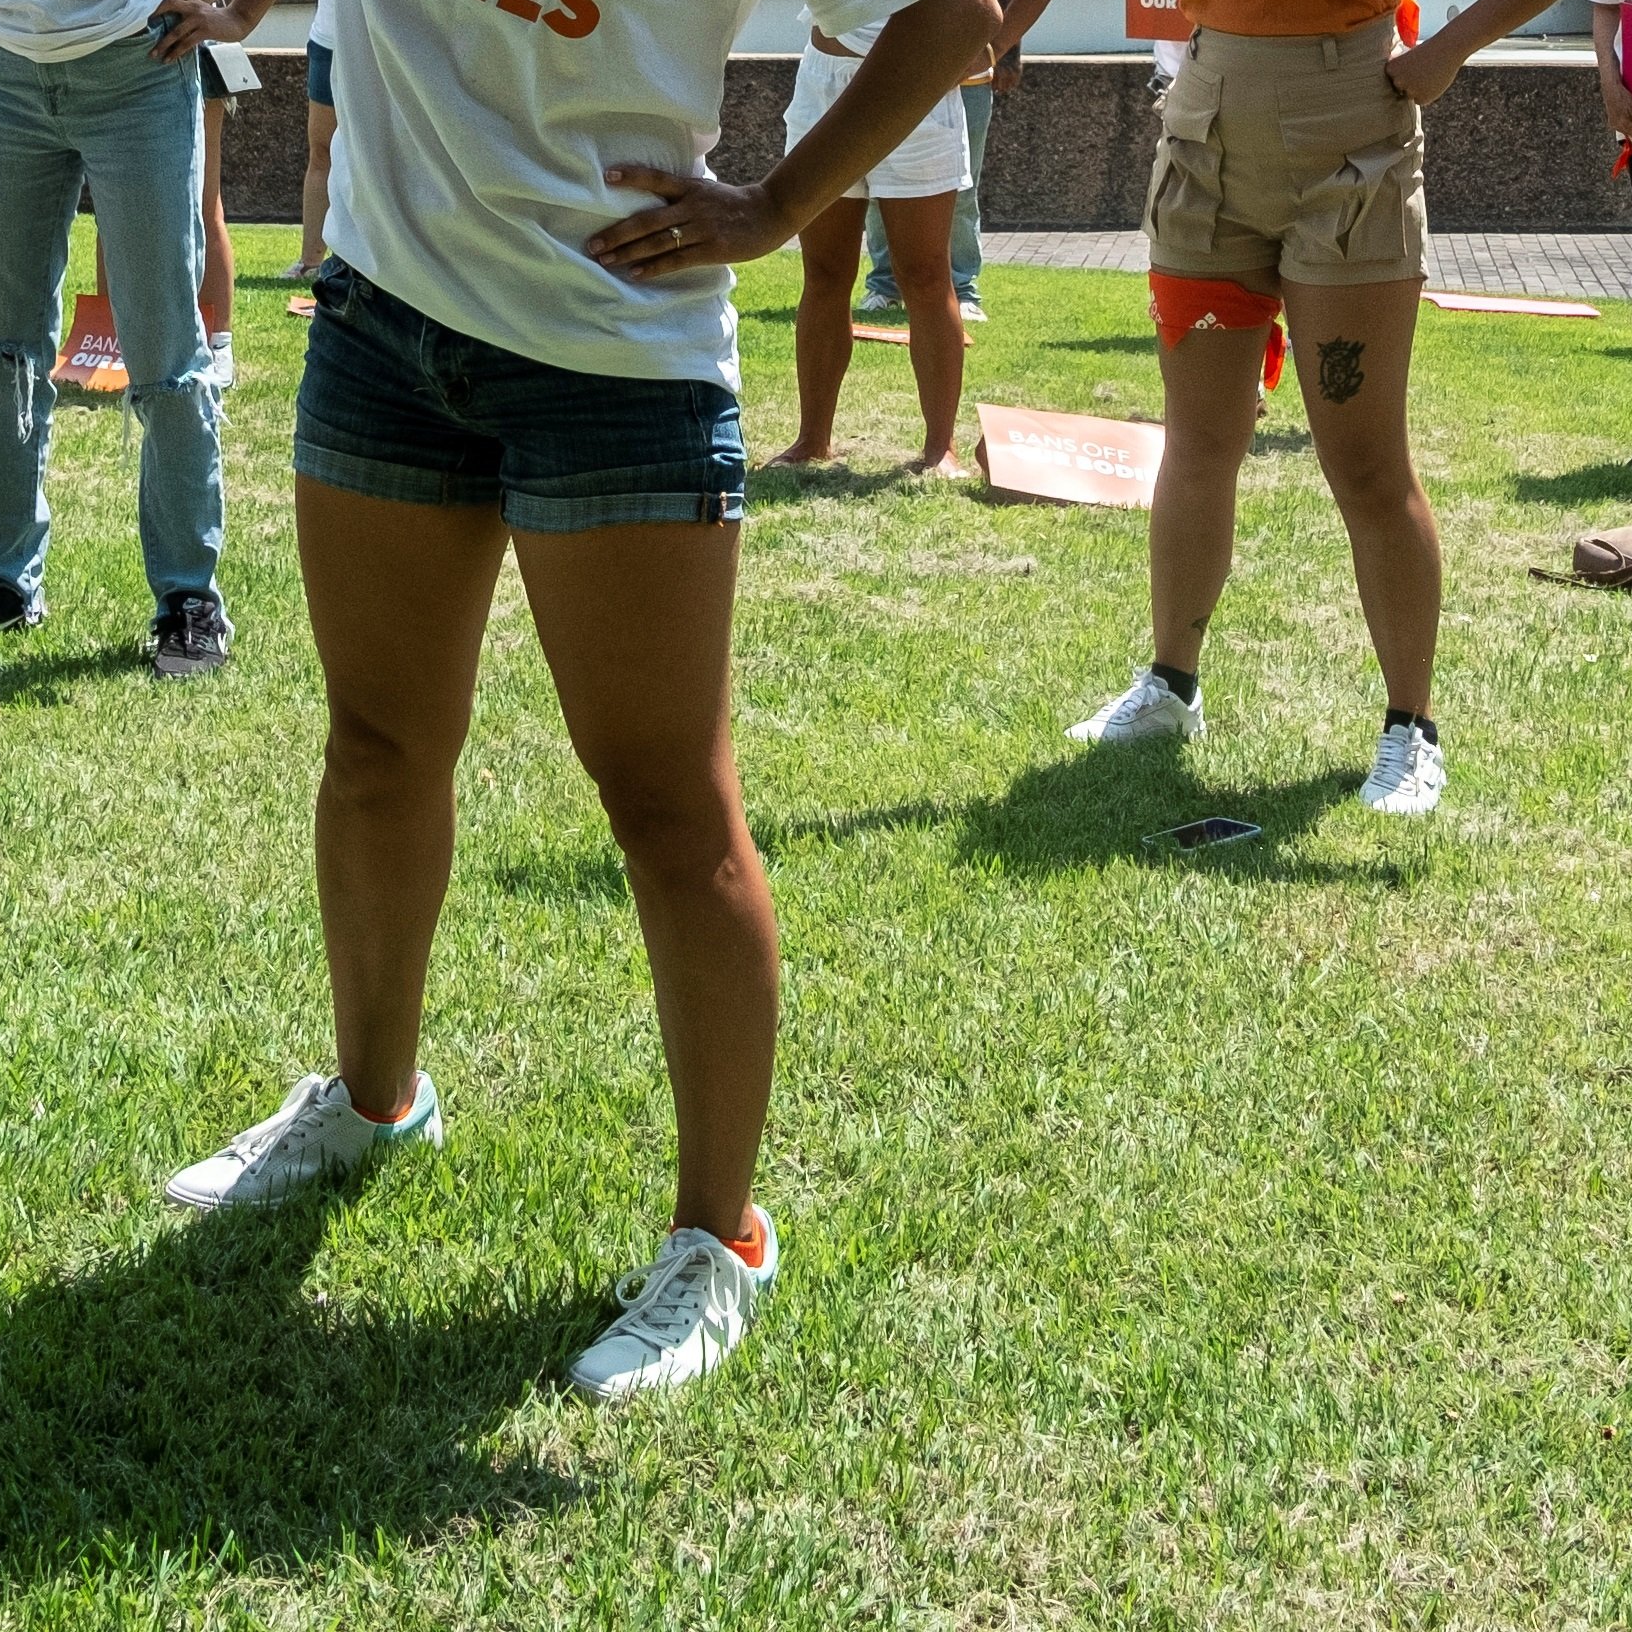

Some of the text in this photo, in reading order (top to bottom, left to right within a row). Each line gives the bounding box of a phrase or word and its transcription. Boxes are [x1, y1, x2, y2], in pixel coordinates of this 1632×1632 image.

[71, 352, 114, 371] OUR
[1008, 430, 1131, 463] BANS OFF
[1075, 454, 1157, 483] BODI
